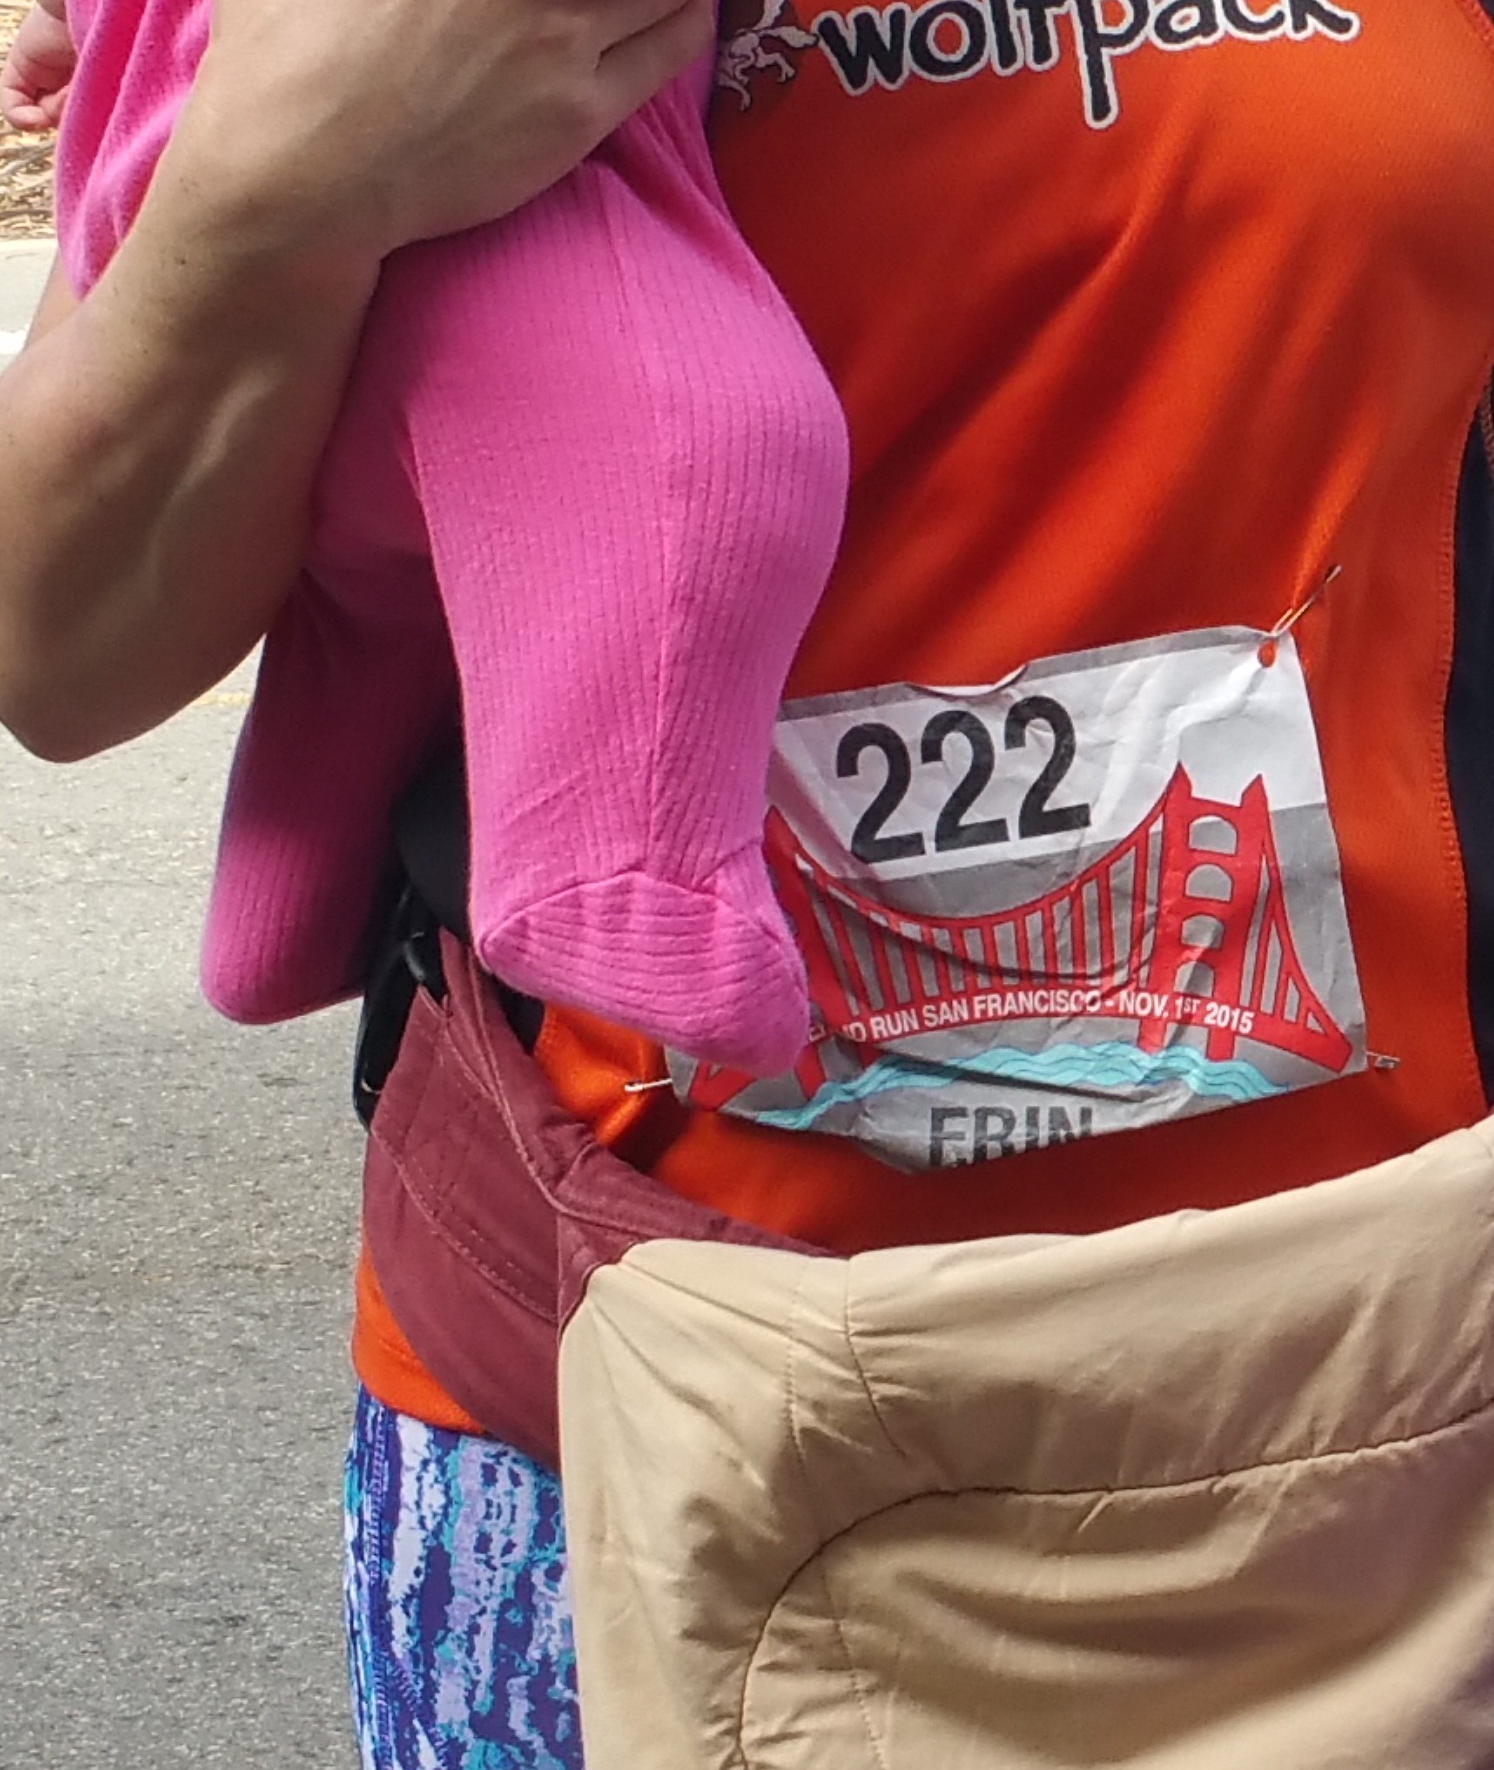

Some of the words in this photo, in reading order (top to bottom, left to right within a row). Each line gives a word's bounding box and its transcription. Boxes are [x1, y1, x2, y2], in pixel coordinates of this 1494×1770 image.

[836, 695, 1092, 863] 222
[870, 1007, 917, 1039] RUN
[922, 998, 969, 1027] SAN
[972, 989, 1101, 1019] FRANCISCO
[1119, 991, 1169, 1018] NOV.
[1204, 1002, 1255, 1033] 2015
[928, 1105, 1094, 1167] ERIN
